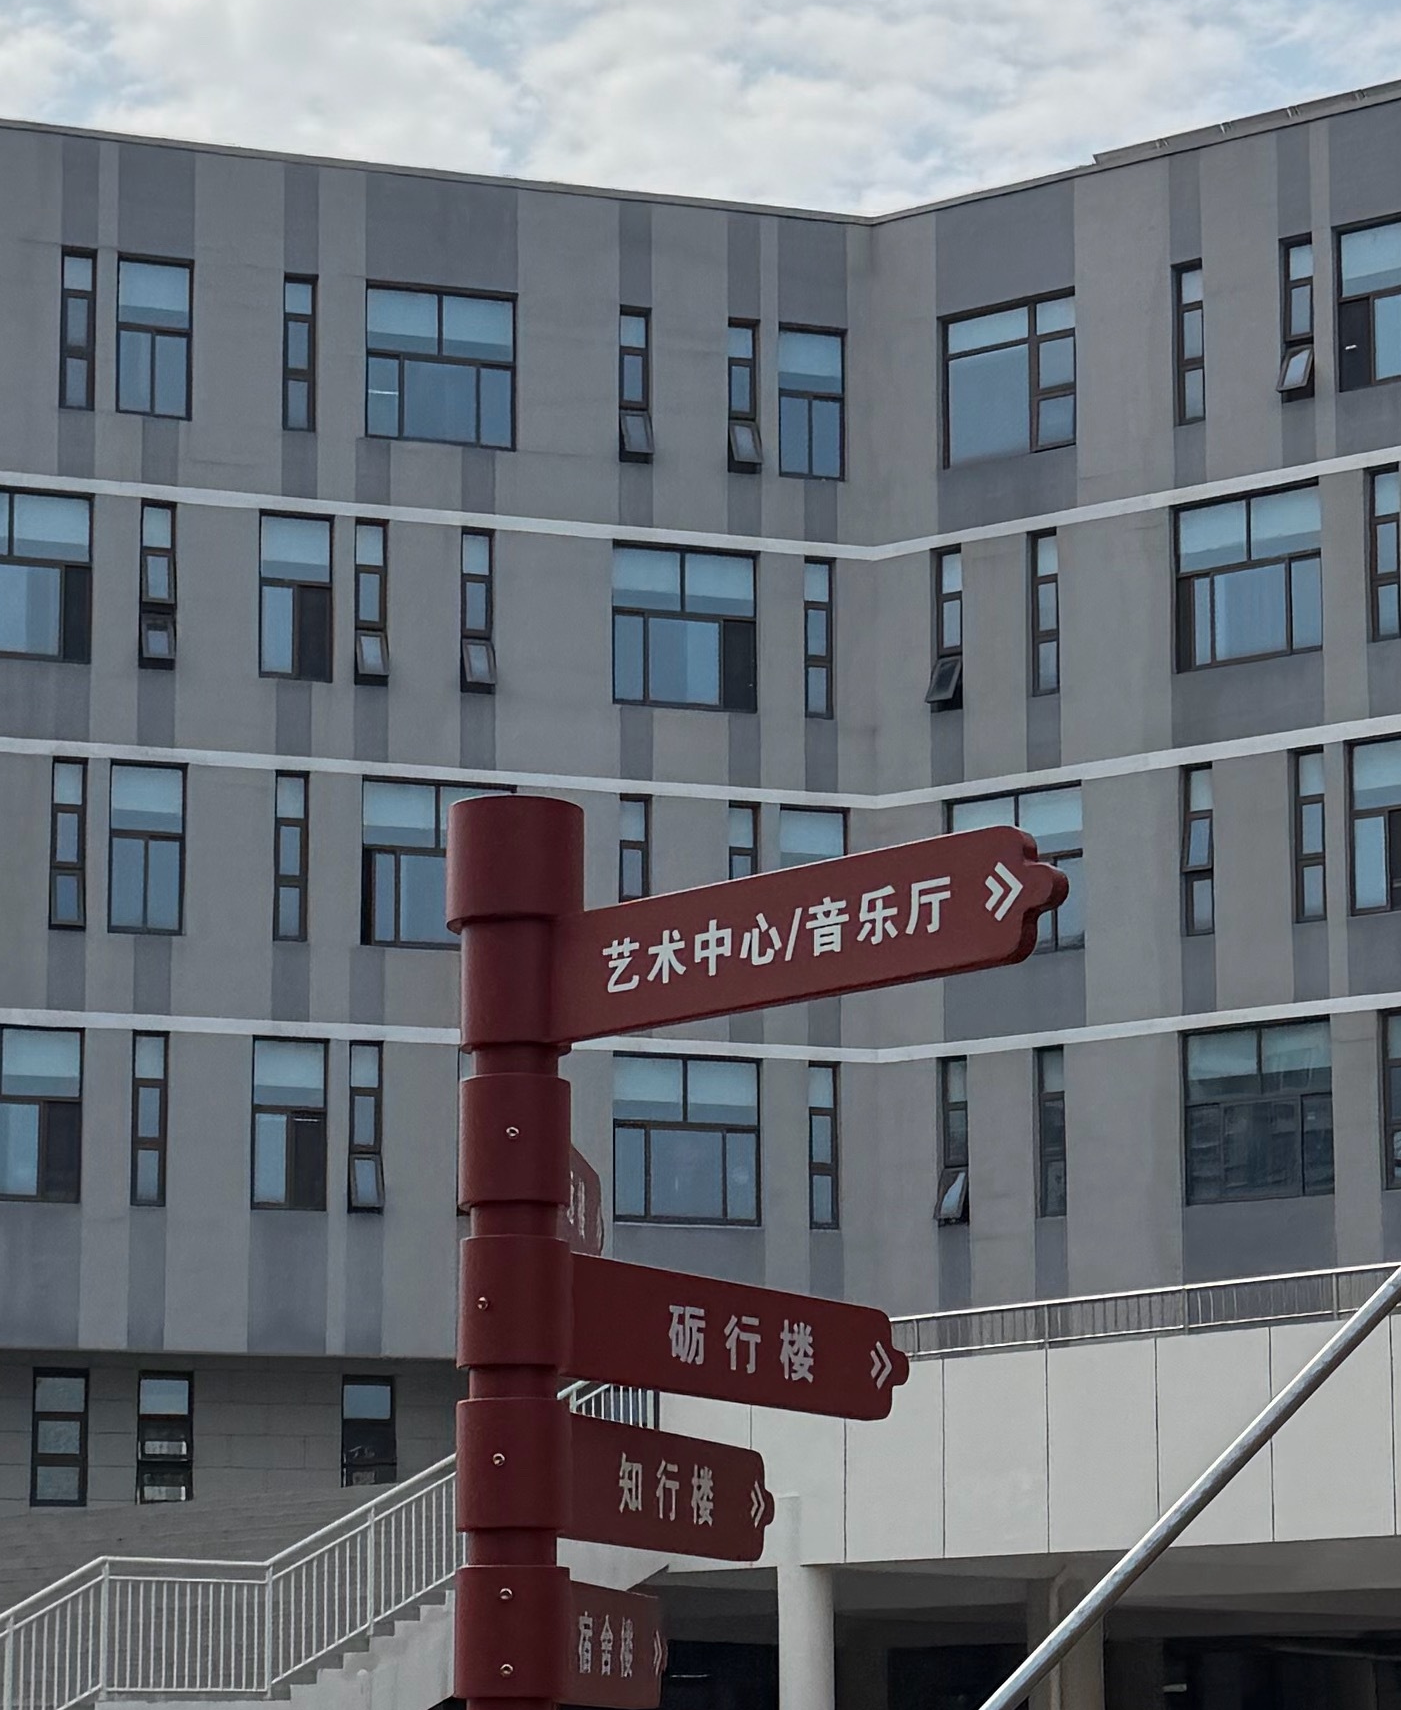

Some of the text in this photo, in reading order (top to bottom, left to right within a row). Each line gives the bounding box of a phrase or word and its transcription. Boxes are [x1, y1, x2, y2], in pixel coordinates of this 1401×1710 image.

[601, 875, 952, 994] 艺术中心/音乐厅
[668, 1304, 815, 1384] 砺行楼
[618, 1451, 714, 1528] 知行楼
